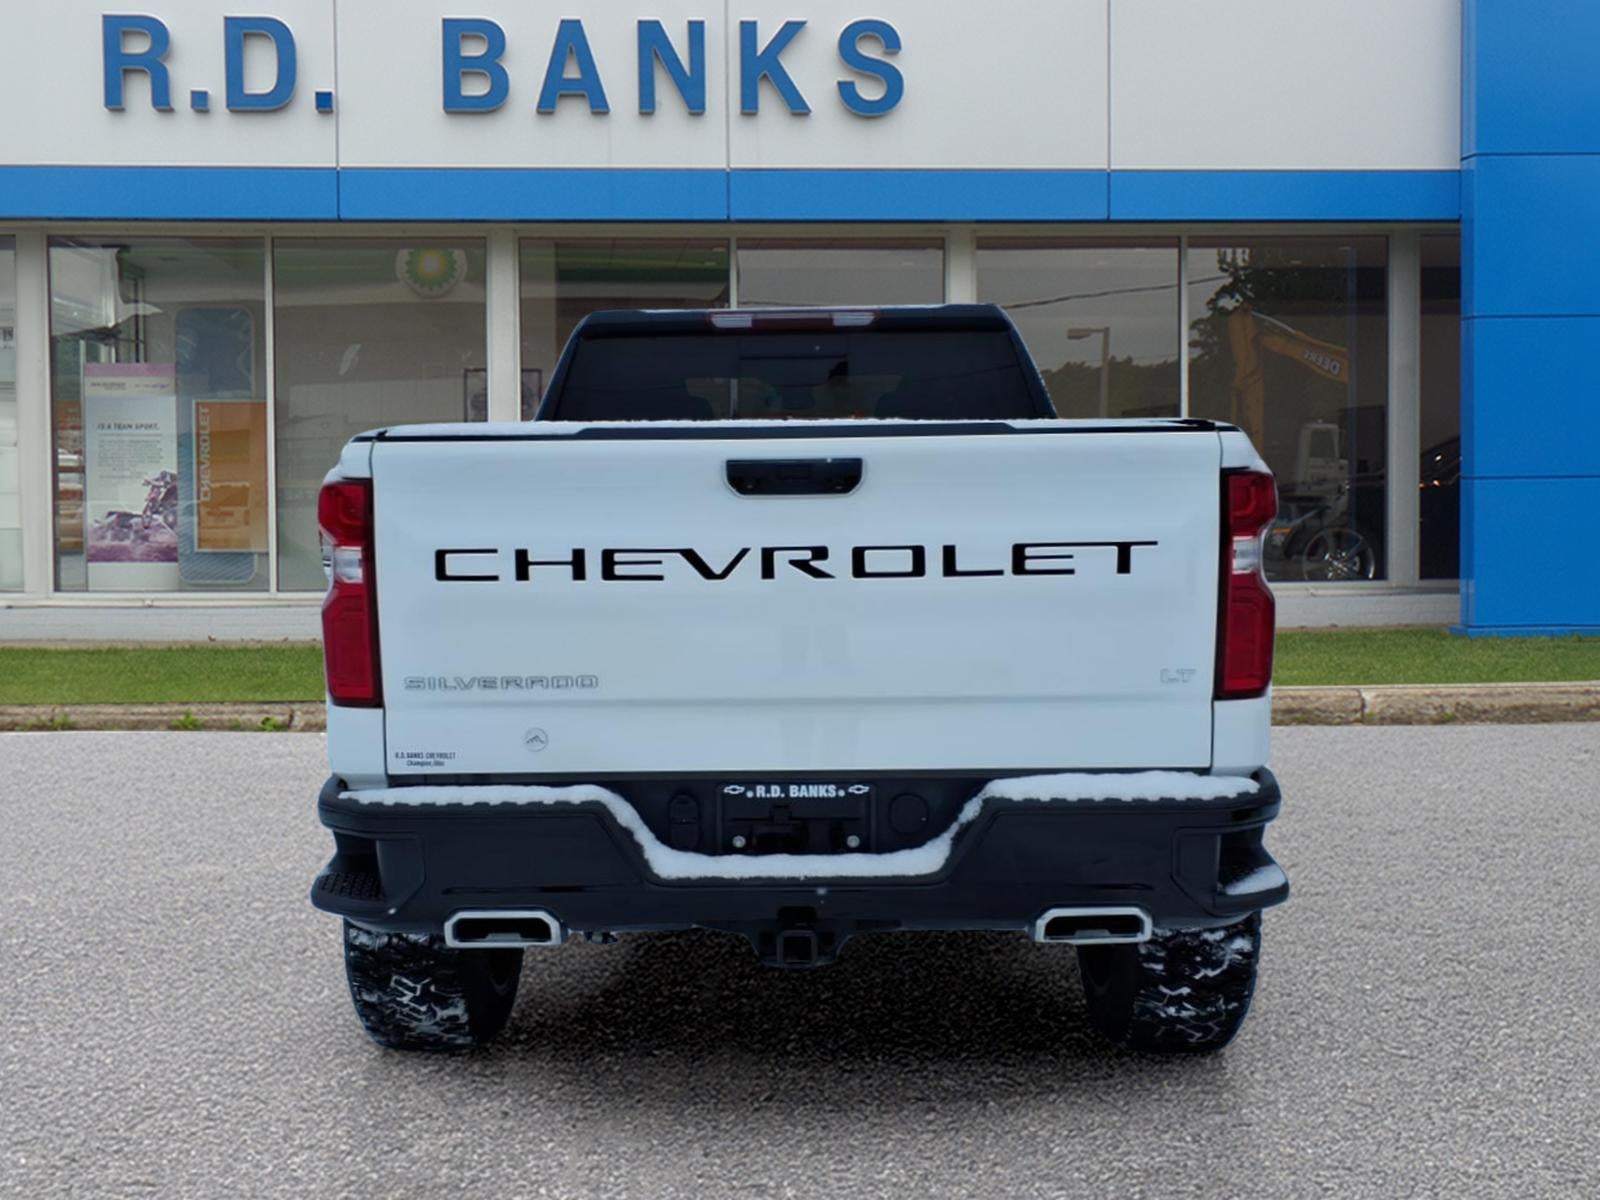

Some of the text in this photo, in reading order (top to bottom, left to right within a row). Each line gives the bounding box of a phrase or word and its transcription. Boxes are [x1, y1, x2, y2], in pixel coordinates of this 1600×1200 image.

[102, 14, 906, 117] R.D. BANKS
[199, 406, 210, 502] CHEVROLET
[436, 541, 1158, 582] CHEVROLET
[404, 674, 599, 690] SILVERADO
[1160, 668, 1196, 684] LT
[789, 785, 836, 798] BANKS
